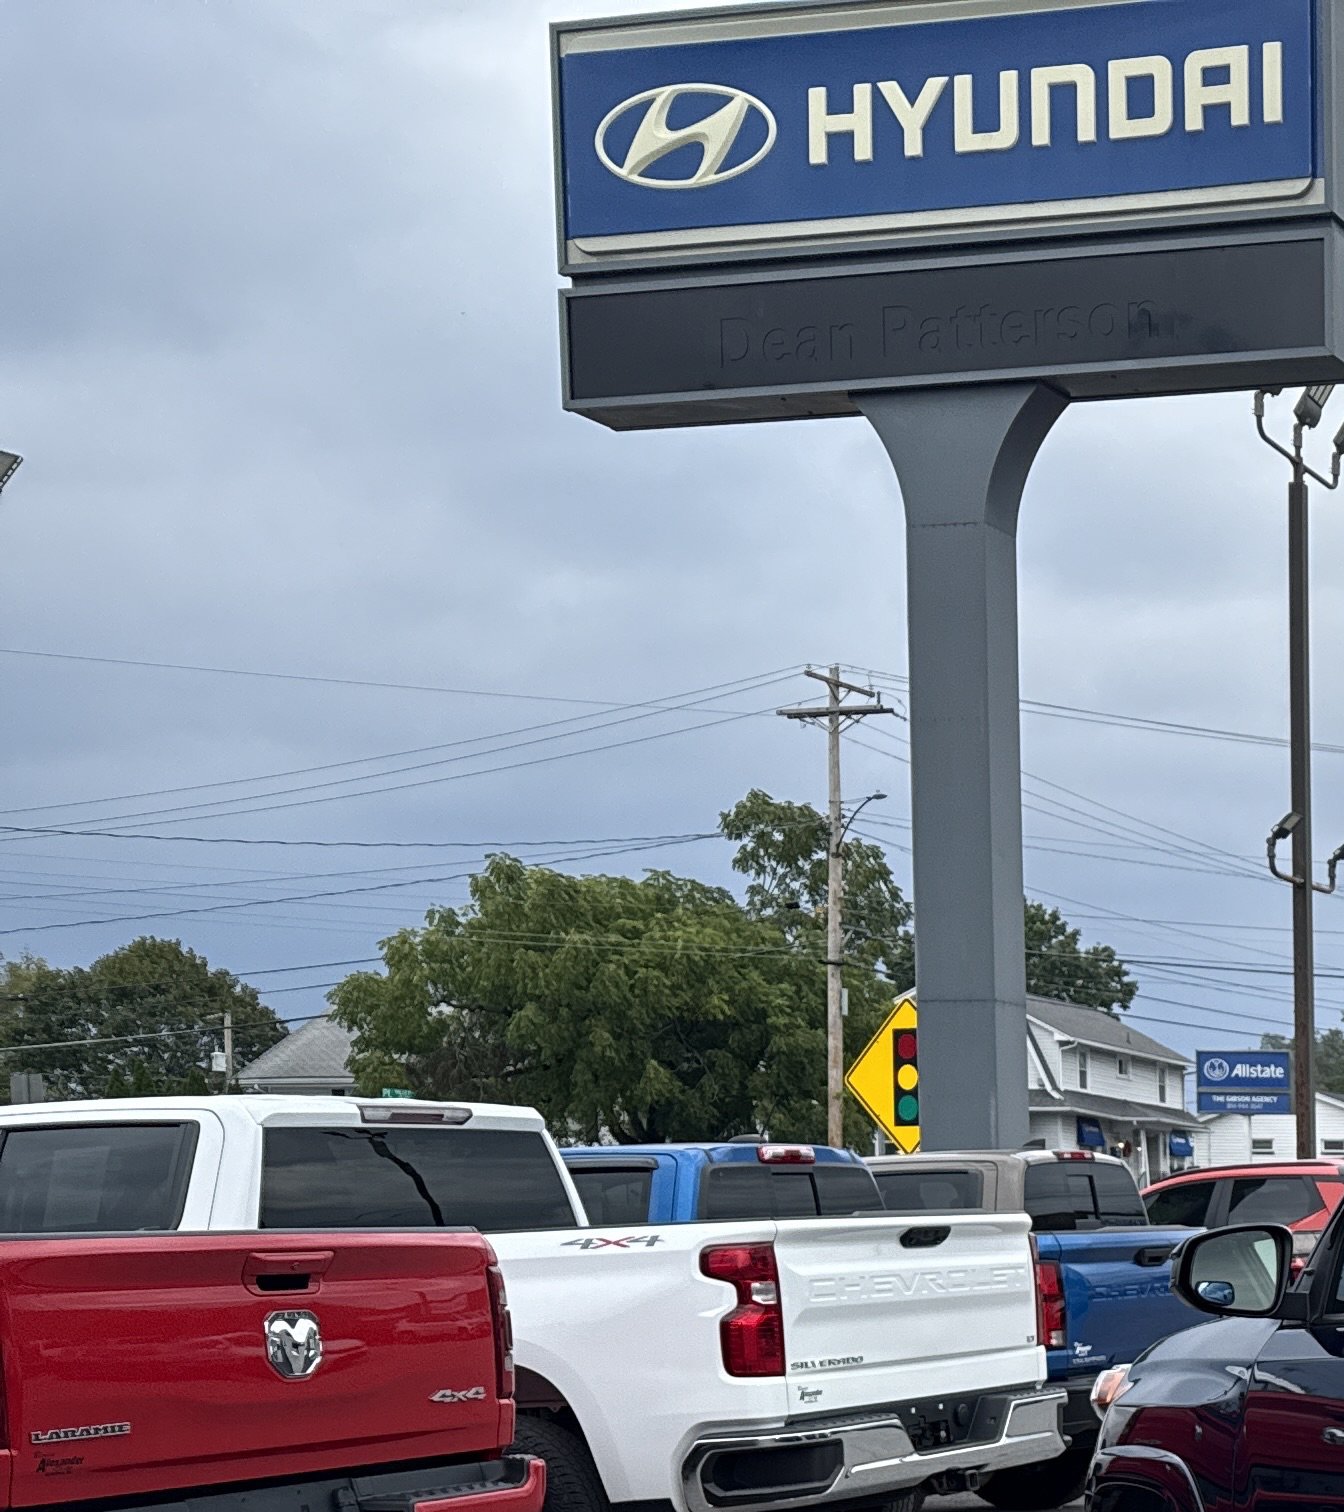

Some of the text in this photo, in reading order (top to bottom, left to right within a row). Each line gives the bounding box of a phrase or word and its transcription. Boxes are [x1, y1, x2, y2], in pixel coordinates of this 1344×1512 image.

[807, 41, 1284, 166] HYUNDAI
[719, 299, 1156, 368] Dean Patterson
[1231, 1063, 1284, 1078] Allstate
[808, 1266, 1026, 1302] CHEVROLET
[791, 1356, 864, 1370] SILVERADO
[31, 1421, 131, 1443] LARAMIE
